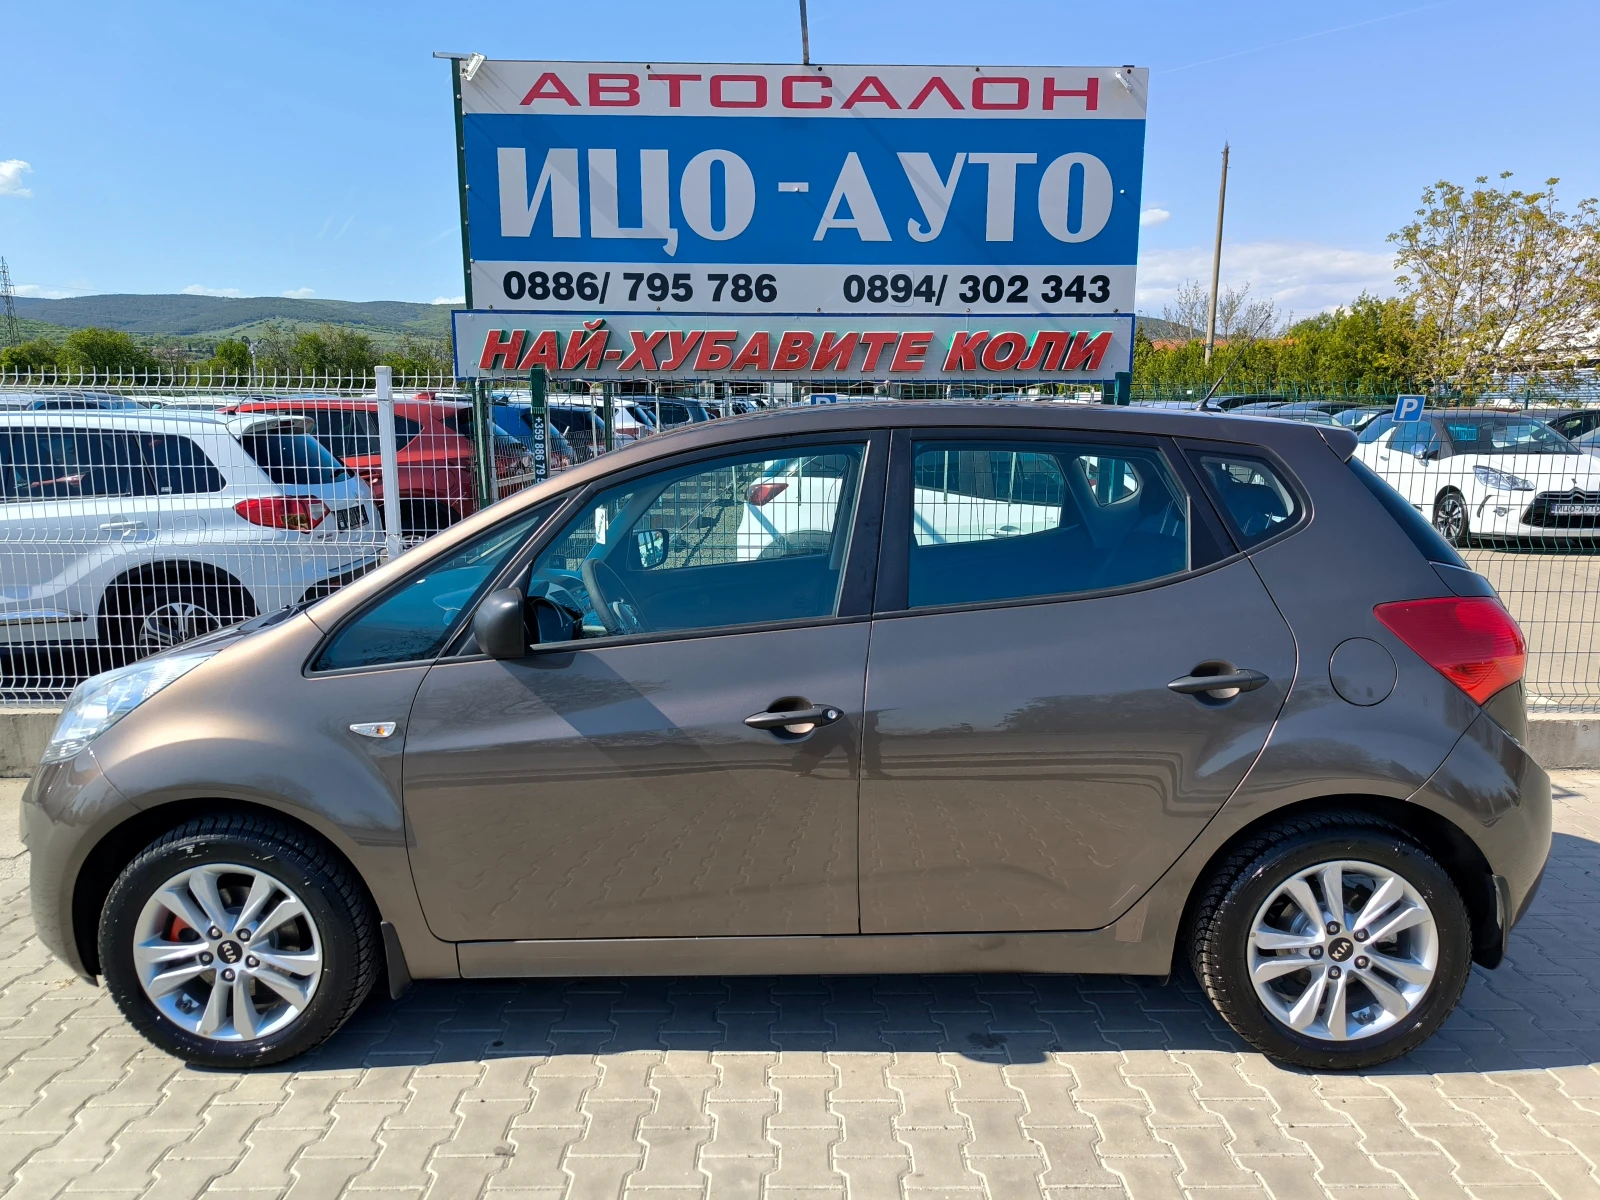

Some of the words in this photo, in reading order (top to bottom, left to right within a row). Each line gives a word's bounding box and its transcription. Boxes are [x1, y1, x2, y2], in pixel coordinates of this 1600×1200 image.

[519, 72, 1099, 110] АВТОСАЛОН
[502, 271, 611, 304] 0886/
[622, 272, 693, 302] 795
[707, 273, 778, 302] 786
[843, 274, 948, 306] 0894/
[958, 275, 1029, 303] 302
[1041, 275, 1111, 303] 343
[478, 318, 934, 372] НАЙ-ХУБАВИТЕ
[942, 329, 1114, 372] КОЛИ
[1399, 399, 1418, 418] P
[534, 416, 544, 440] +359
[535, 443, 545, 460] 886
[223, 942, 237, 963] KIA
[1332, 941, 1350, 960] KIA
